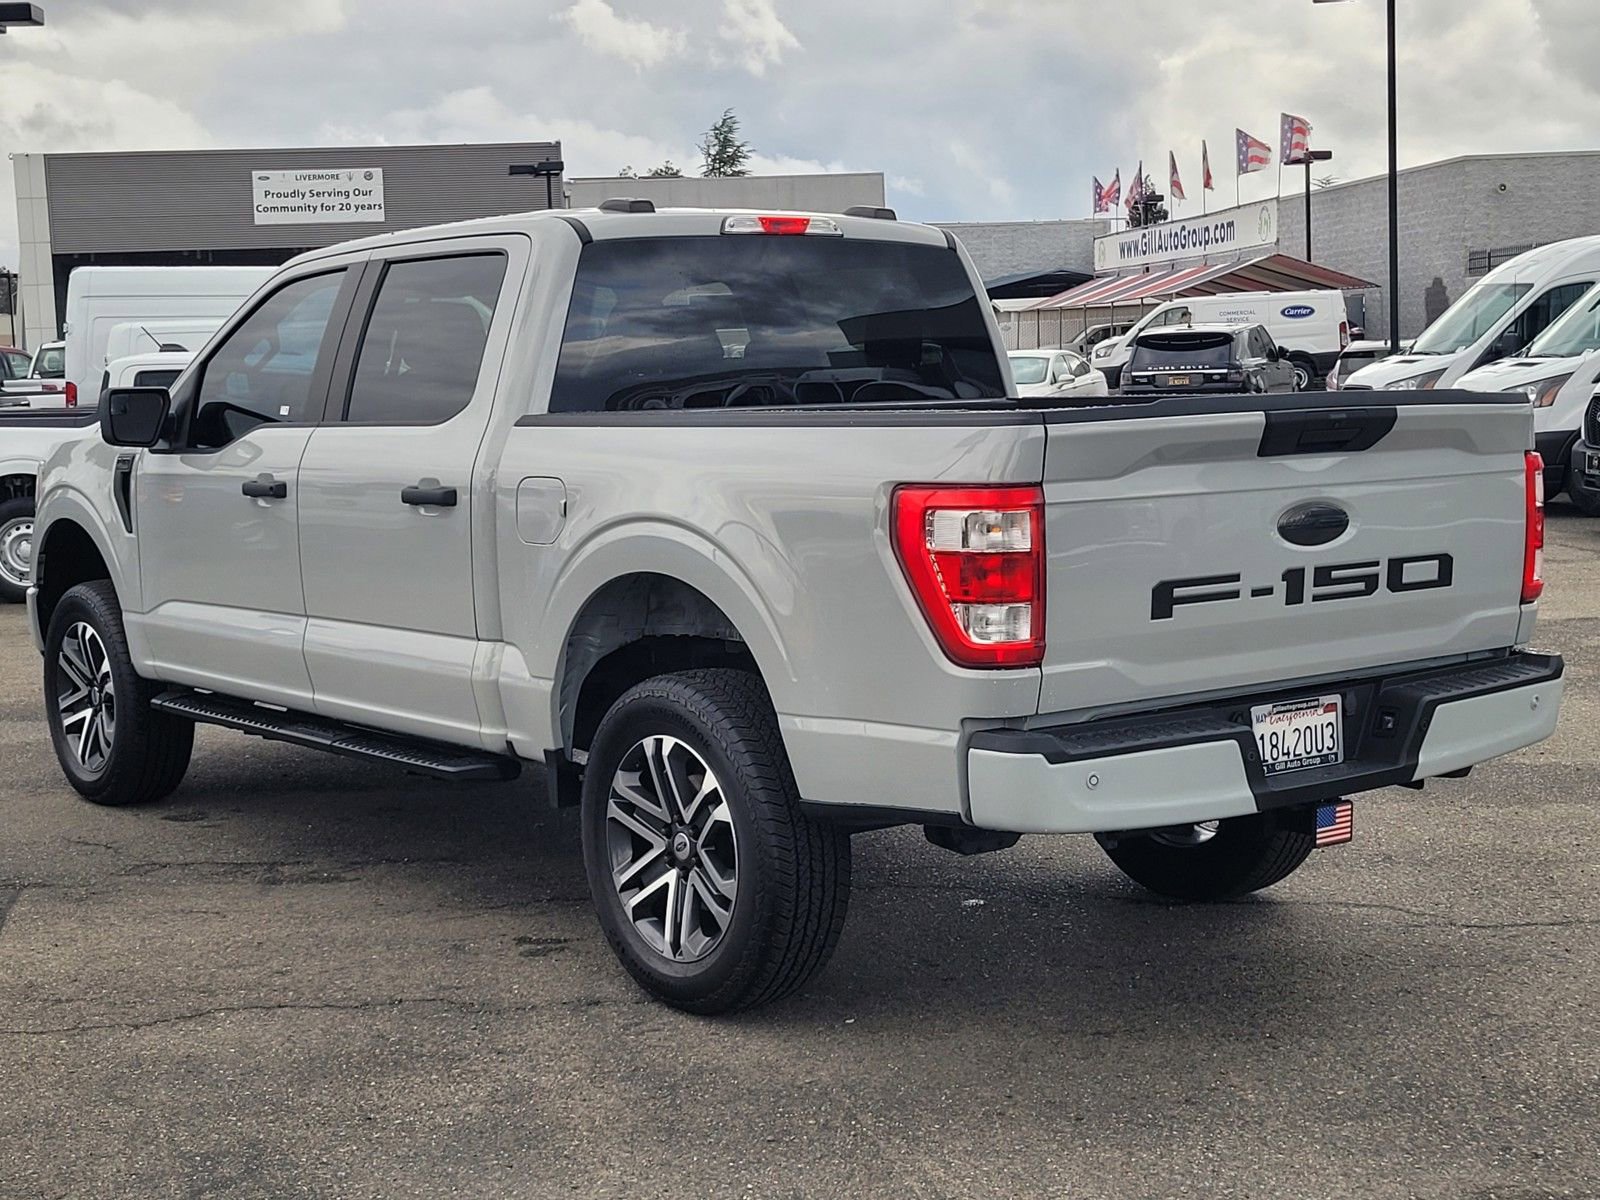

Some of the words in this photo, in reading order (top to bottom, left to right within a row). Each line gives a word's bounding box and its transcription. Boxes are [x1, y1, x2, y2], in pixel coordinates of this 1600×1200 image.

[295, 173, 341, 181] LIVERMORE
[264, 189, 307, 200] Proudly
[308, 188, 350, 199] Serving
[352, 187, 373, 197] Our
[255, 203, 318, 214] Community
[320, 202, 336, 212] for
[338, 202, 352, 211] 20
[354, 202, 383, 213] years
[1118, 219, 1236, 260] www.GillAutoGroup.com
[1219, 309, 1256, 317] COMMERCIAL
[1284, 307, 1312, 316] Carrier
[1150, 552, 1454, 621] F-150
[1258, 721, 1336, 763] 18420U3
[1274, 763, 1286, 771] Gill
[1286, 760, 1301, 769] Auto
[1301, 757, 1321, 766] Group
